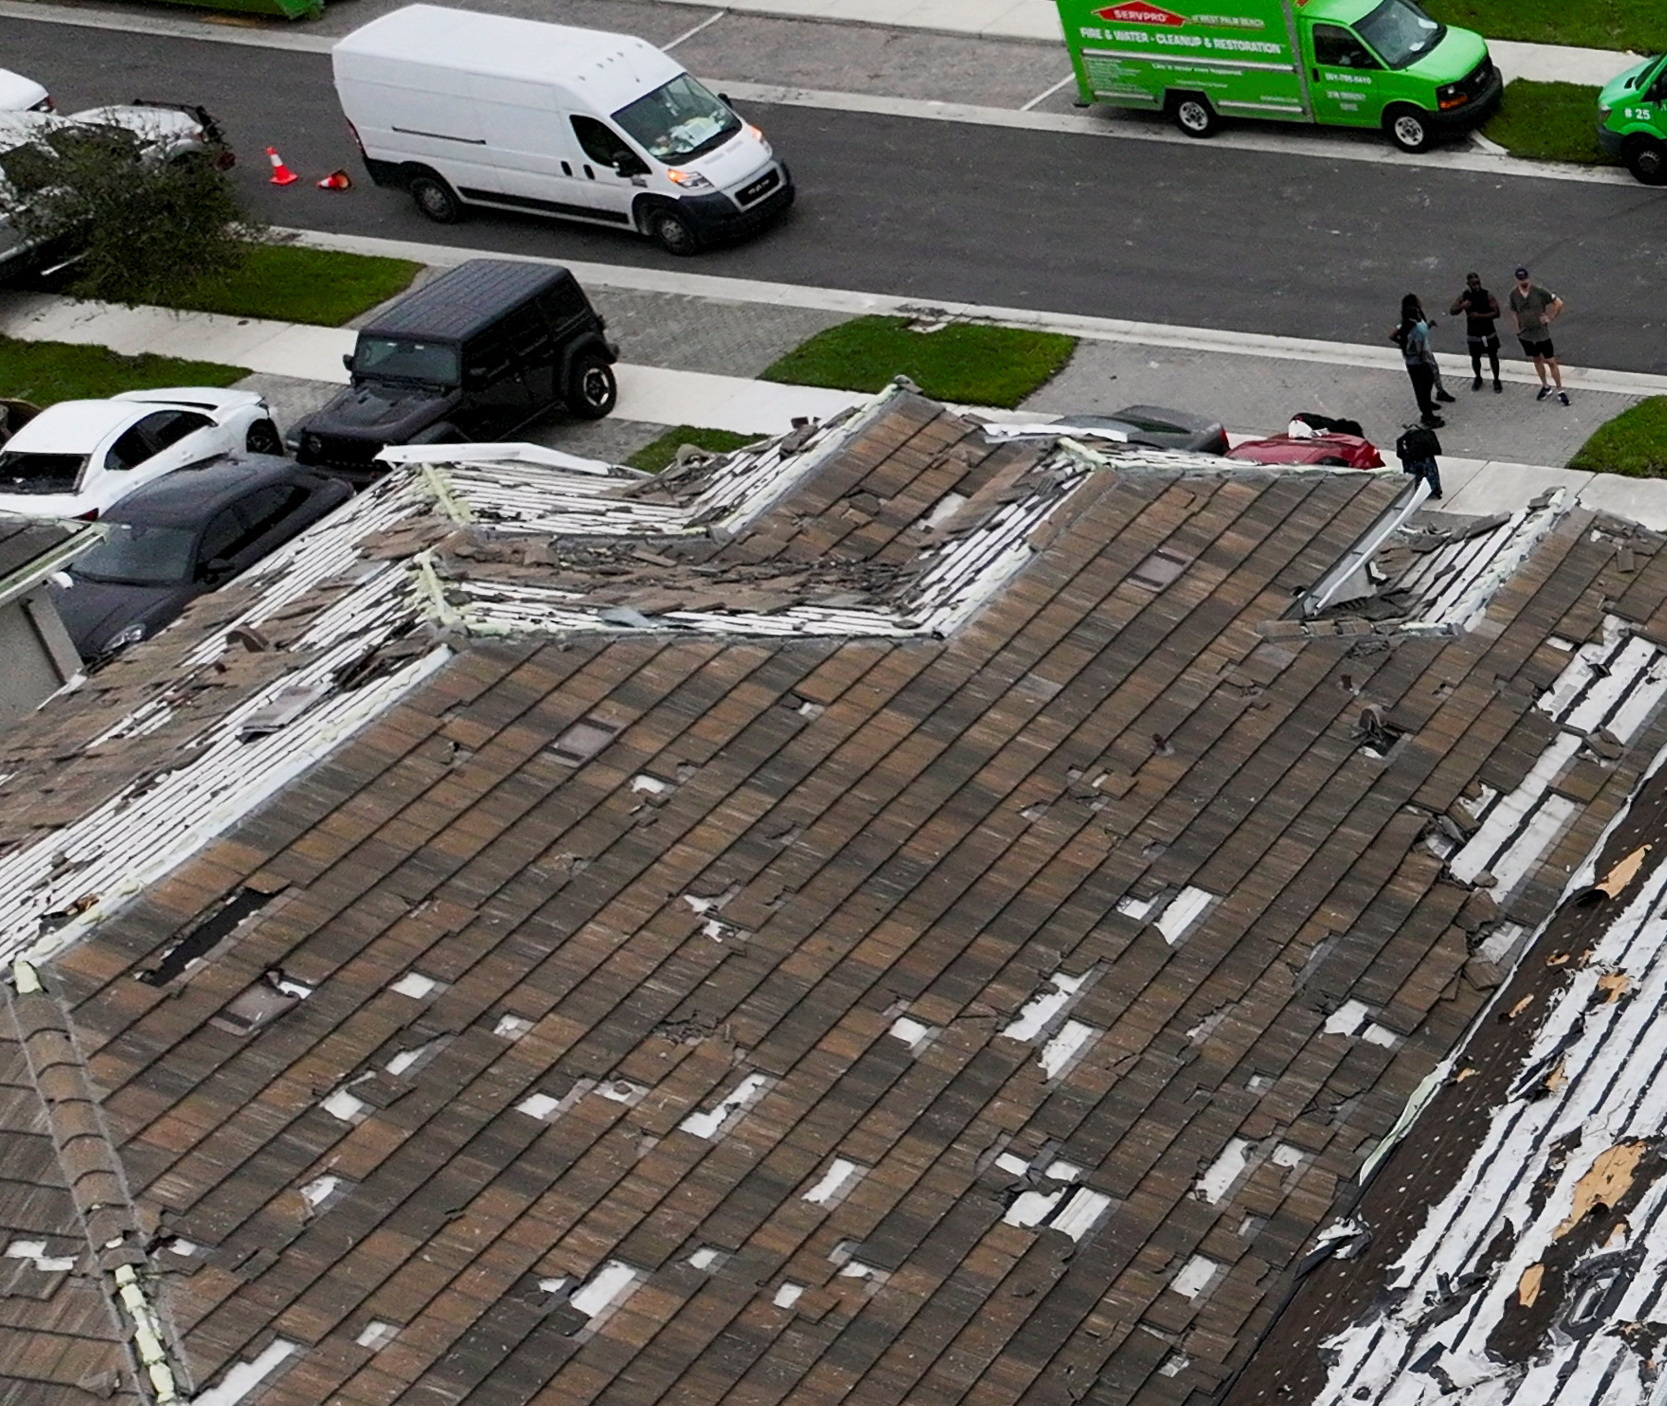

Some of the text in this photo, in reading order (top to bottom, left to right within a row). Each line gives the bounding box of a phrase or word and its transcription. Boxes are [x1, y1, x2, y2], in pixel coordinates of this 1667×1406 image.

[1113, 9, 1167, 23] SERVPRO
[1156, 33, 1202, 47] CLEANUP
[1635, 108, 1651, 120] 25
